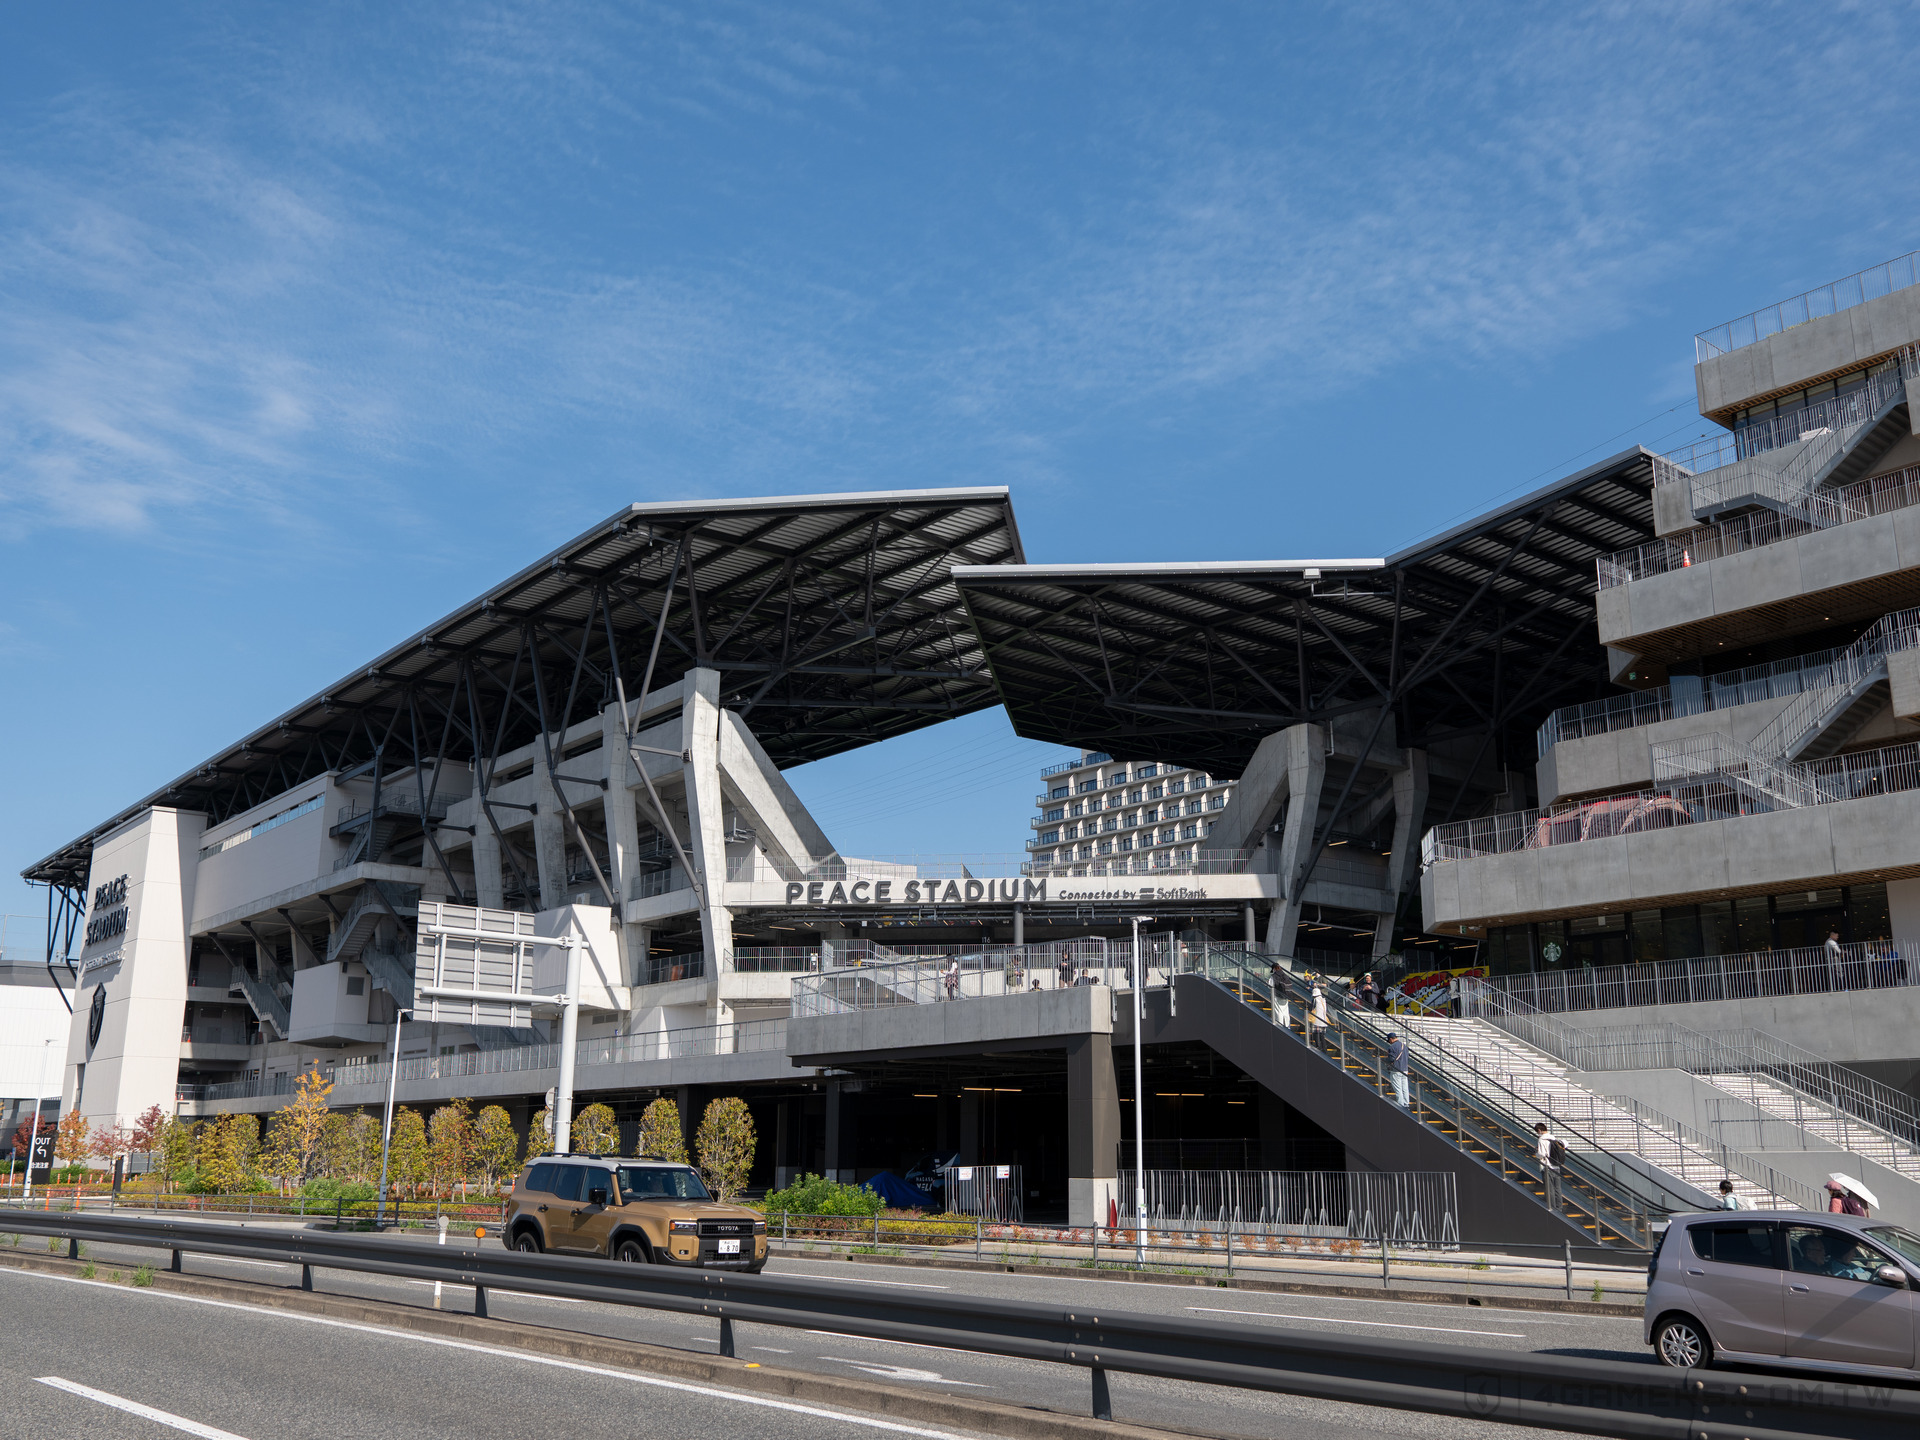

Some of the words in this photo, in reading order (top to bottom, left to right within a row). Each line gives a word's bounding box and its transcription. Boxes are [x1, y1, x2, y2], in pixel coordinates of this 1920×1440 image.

[94, 874, 128, 911] PEACE
[786, 881, 892, 904] PEACE
[904, 879, 1047, 903] STADIUM
[1059, 889, 1120, 900] Connected
[1122, 889, 1137, 900] by
[1156, 887, 1207, 900] SoftBank
[85, 906, 129, 946] STADIUM
[35, 1137, 51, 1145] OUT
